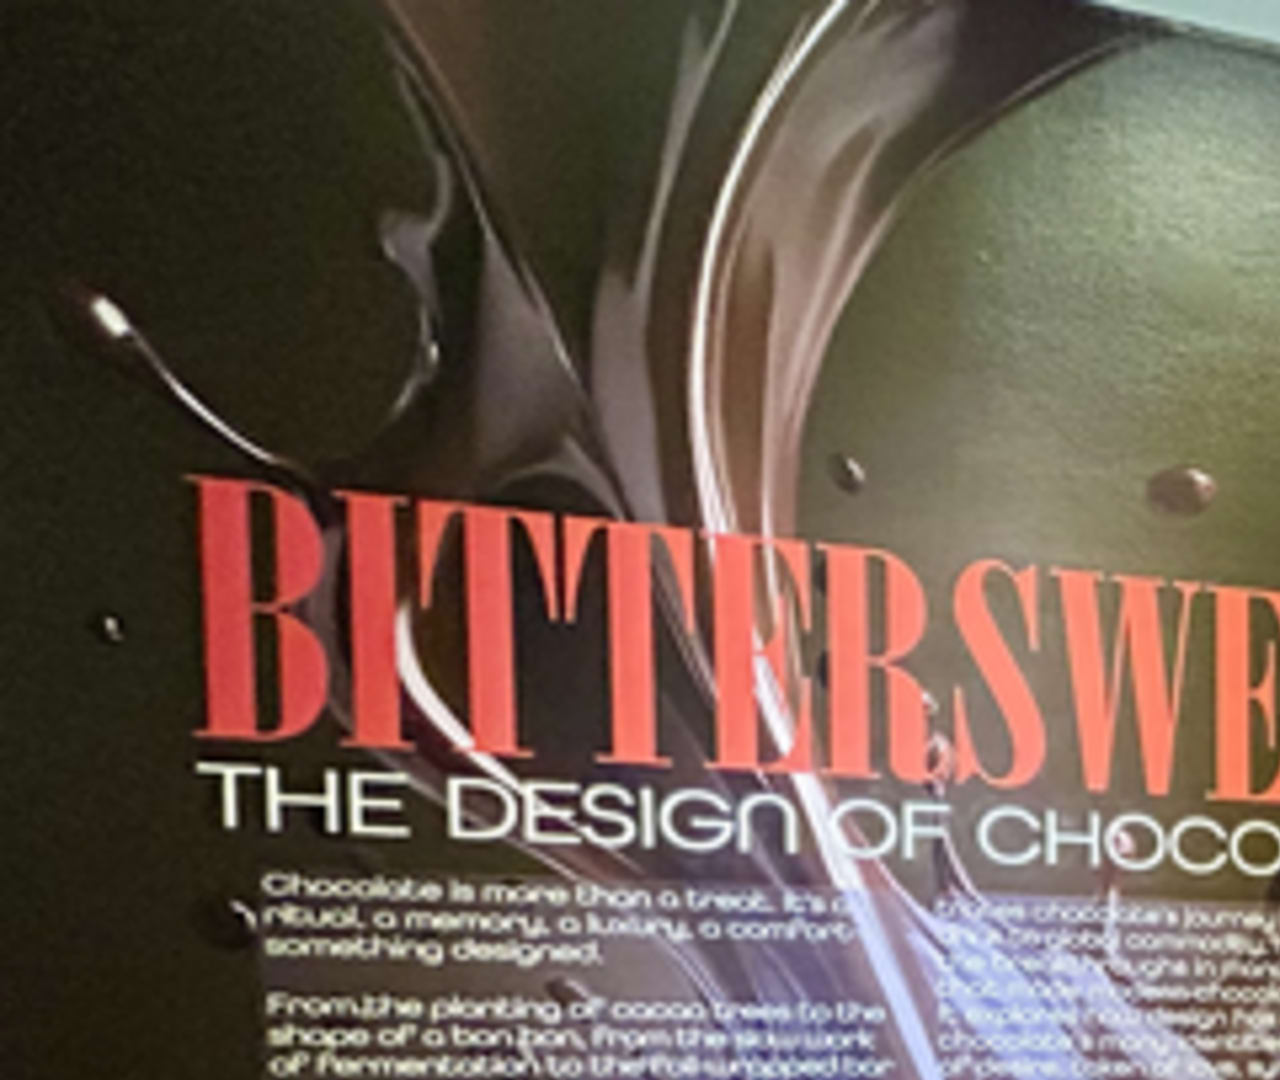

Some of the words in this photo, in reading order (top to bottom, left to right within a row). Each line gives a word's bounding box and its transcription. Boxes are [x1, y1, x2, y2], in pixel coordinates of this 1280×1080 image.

[196, 761, 412, 837] THE
[447, 776, 798, 856] DESIGN
[828, 798, 952, 860] OF
[261, 872, 443, 899] Chocolate
[449, 880, 475, 901] is
[481, 884, 569, 904] more
[575, 882, 651, 907] than
[659, 891, 678, 908] a
[686, 888, 774, 912] treat.
[784, 890, 826, 913] It's
[373, 909, 397, 929] a
[404, 910, 549, 938] memory,
[558, 914, 580, 935] a
[699, 921, 720, 939] a
[265, 936, 444, 967] something
[452, 940, 605, 968] designed.
[266, 990, 348, 1017] From
[351, 994, 423, 1019] the
[431, 996, 562, 1023] planting
[570, 995, 605, 1021] of
[612, 1003, 704, 1021] cacao
[714, 1001, 790, 1022] trees
[802, 1001, 833, 1022] to
[837, 1001, 886, 1022] the
[267, 1024, 370, 1051] shape
[377, 1024, 418, 1047] of
[422, 1030, 445, 1047] a
[591, 1025, 672, 1049] from
[676, 1026, 727, 1047] the
[268, 1053, 308, 1077] of
[315, 1053, 541, 1077] fermentation
[548, 1054, 583, 1077] to
[590, 1054, 647, 1077] the
[843, 1054, 896, 1077] bar
